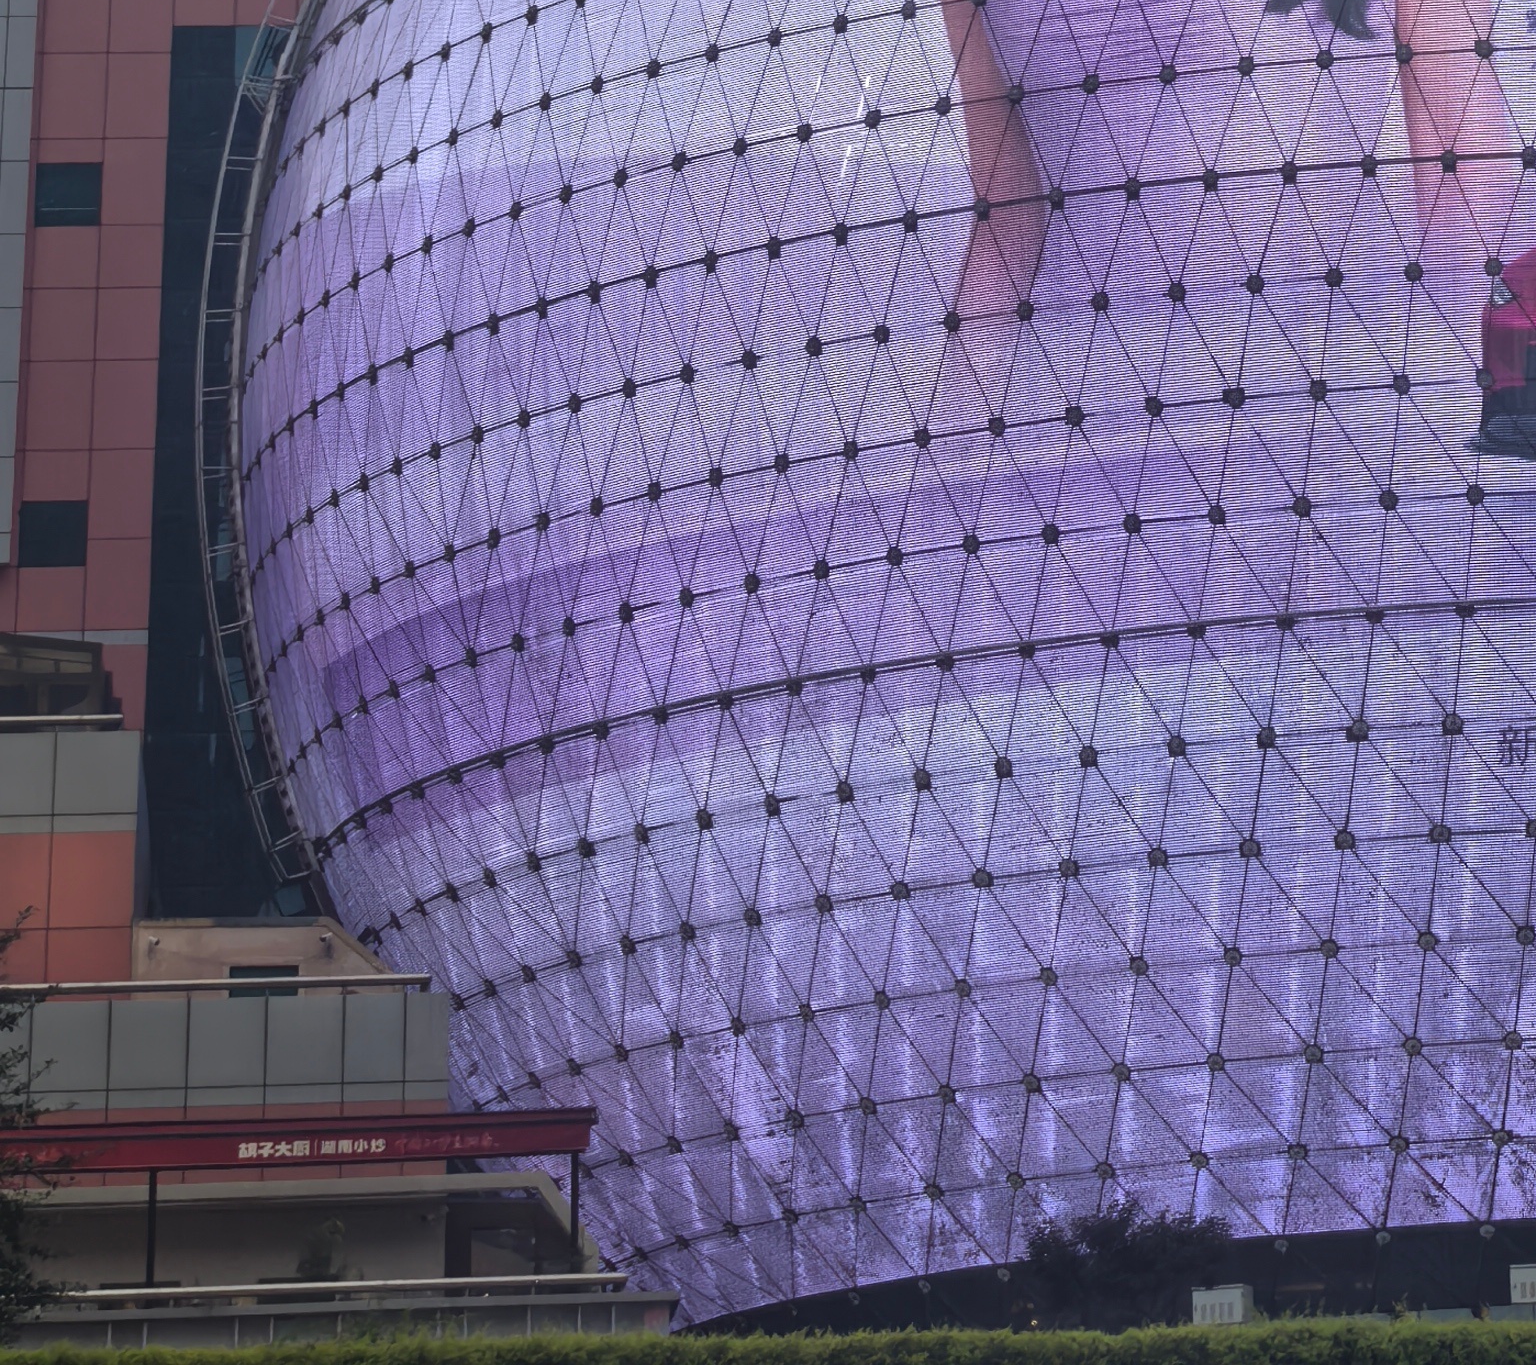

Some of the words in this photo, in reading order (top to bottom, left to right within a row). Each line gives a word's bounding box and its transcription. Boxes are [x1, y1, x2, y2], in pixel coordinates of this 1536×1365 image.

[238, 1139, 311, 1159] 胡子大厨
[320, 1138, 387, 1155] 湖南小炒
